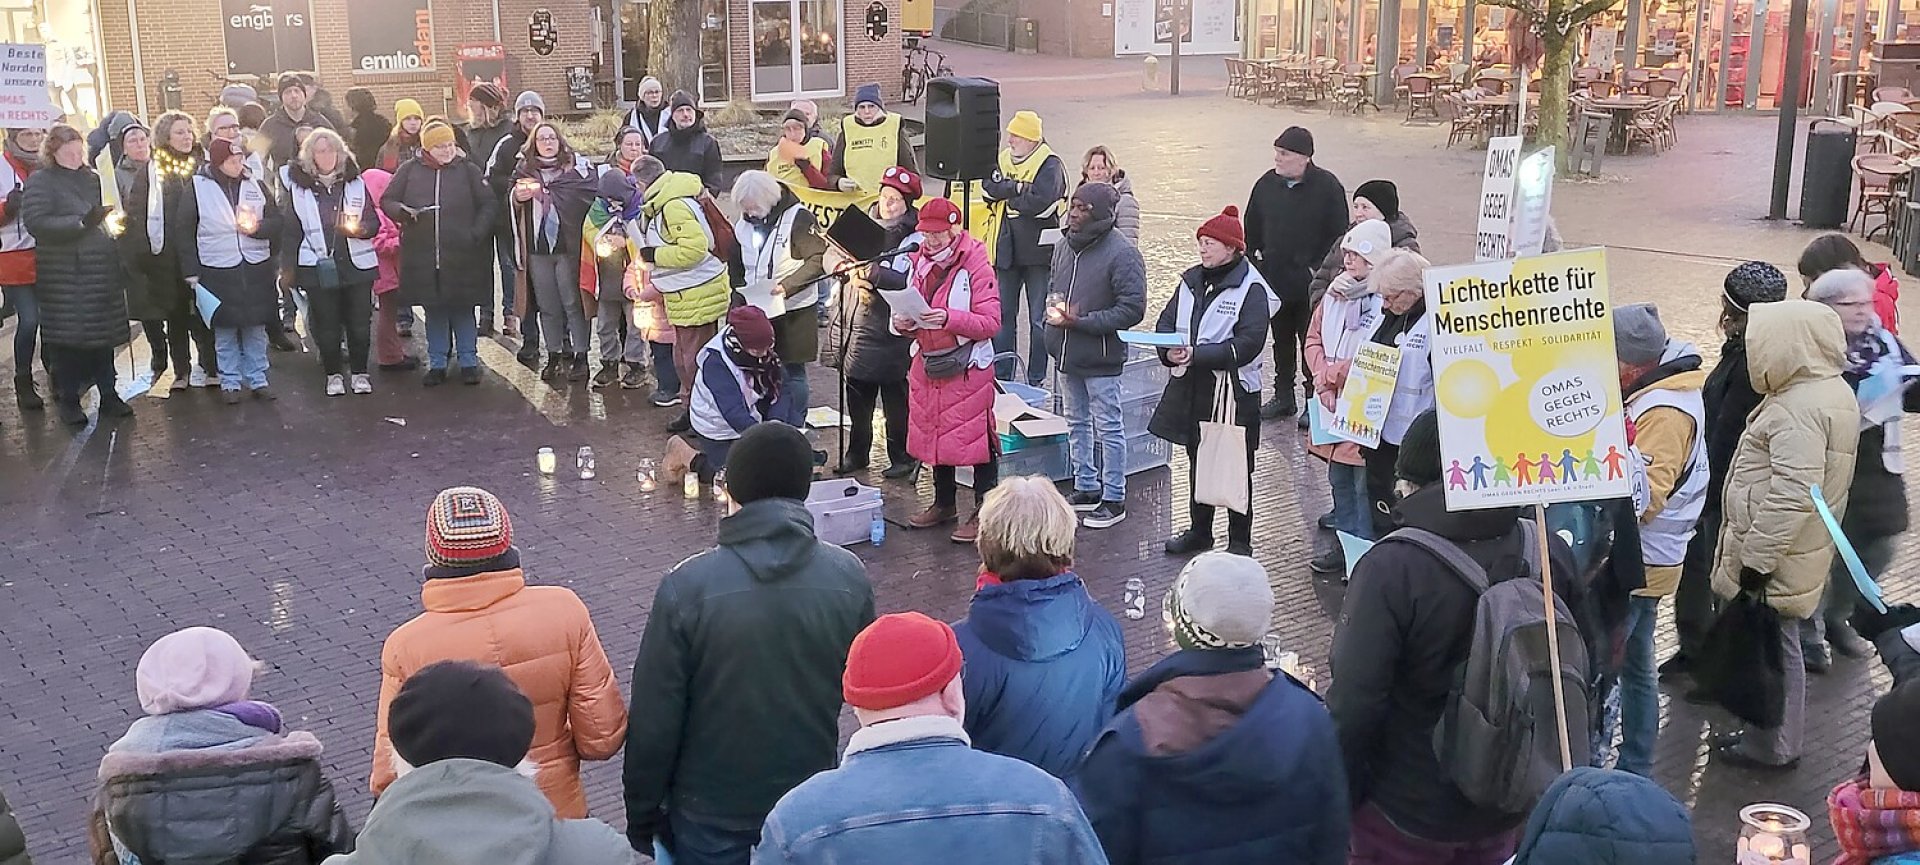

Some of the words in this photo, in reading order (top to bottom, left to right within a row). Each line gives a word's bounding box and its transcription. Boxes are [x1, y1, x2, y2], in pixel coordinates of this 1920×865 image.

[230, 11, 304, 30] engbrs
[413, 10, 431, 67] adani
[8, 48, 44, 59] Beste
[361, 51, 419, 70] emilio
[2, 63, 43, 73] Norden
[4, 79, 45, 87] unsere
[8, 110, 49, 121] RECHTS
[1489, 149, 1515, 178] OMAS
[1483, 193, 1509, 219] GEGEN
[1477, 231, 1506, 259] RECHTS
[1437, 272, 1560, 306] Lichterkette
[1565, 266, 1597, 291] für
[1435, 297, 1606, 335] Menschenrechte
[1443, 343, 1484, 355] VIELFALT
[1493, 338, 1533, 351] RESPEKT
[1541, 376, 1583, 397] OMAS
[1544, 390, 1592, 412] GEGEN
[1545, 404, 1601, 429] RECHTS
